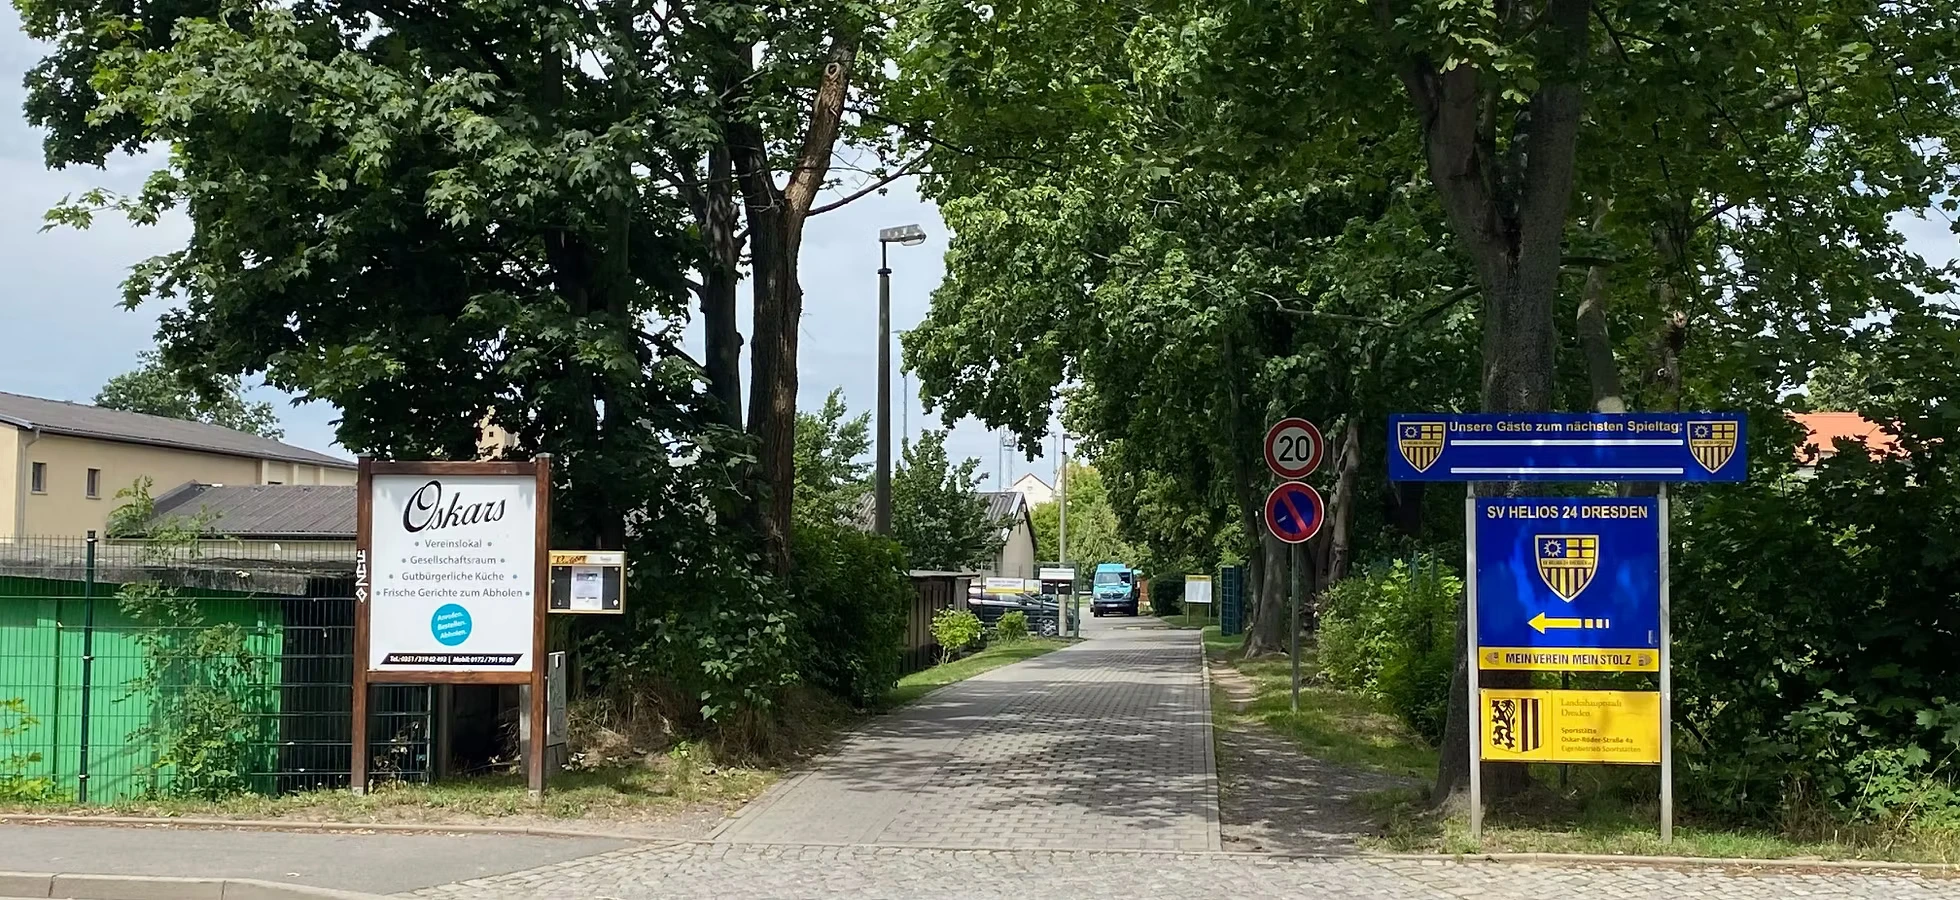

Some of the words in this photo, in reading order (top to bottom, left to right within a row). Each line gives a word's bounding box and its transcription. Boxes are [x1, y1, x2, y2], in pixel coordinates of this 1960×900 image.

[1449, 421, 1493, 432] Unsere
[1496, 421, 1532, 432] Gäste
[1535, 423, 1562, 432] zum
[1566, 420, 1624, 432] nächsten
[1627, 421, 1683, 433] Spieltag:
[1278, 435, 1310, 462] 20
[403, 479, 507, 533] Oskars
[1487, 505, 1505, 519] SV
[1509, 505, 1559, 519] HELIOS
[1562, 505, 1578, 519] 24
[1581, 505, 1648, 519] DRESDEN
[424, 539, 482, 548] Vereinslokal
[410, 555, 497, 565] Gesellschaftsraum
[402, 571, 474, 583] Gutbürgerliche
[475, 571, 505, 581] Küche
[383, 588, 416, 597] Frische
[418, 588, 458, 597] Gerichte
[482, 588, 523, 597] Abholen
[1505, 653, 1531, 664] MEIN
[1532, 653, 1569, 664] VEREIN
[1572, 654, 1599, 665] MEIN
[1600, 654, 1631, 665] STOLZ
